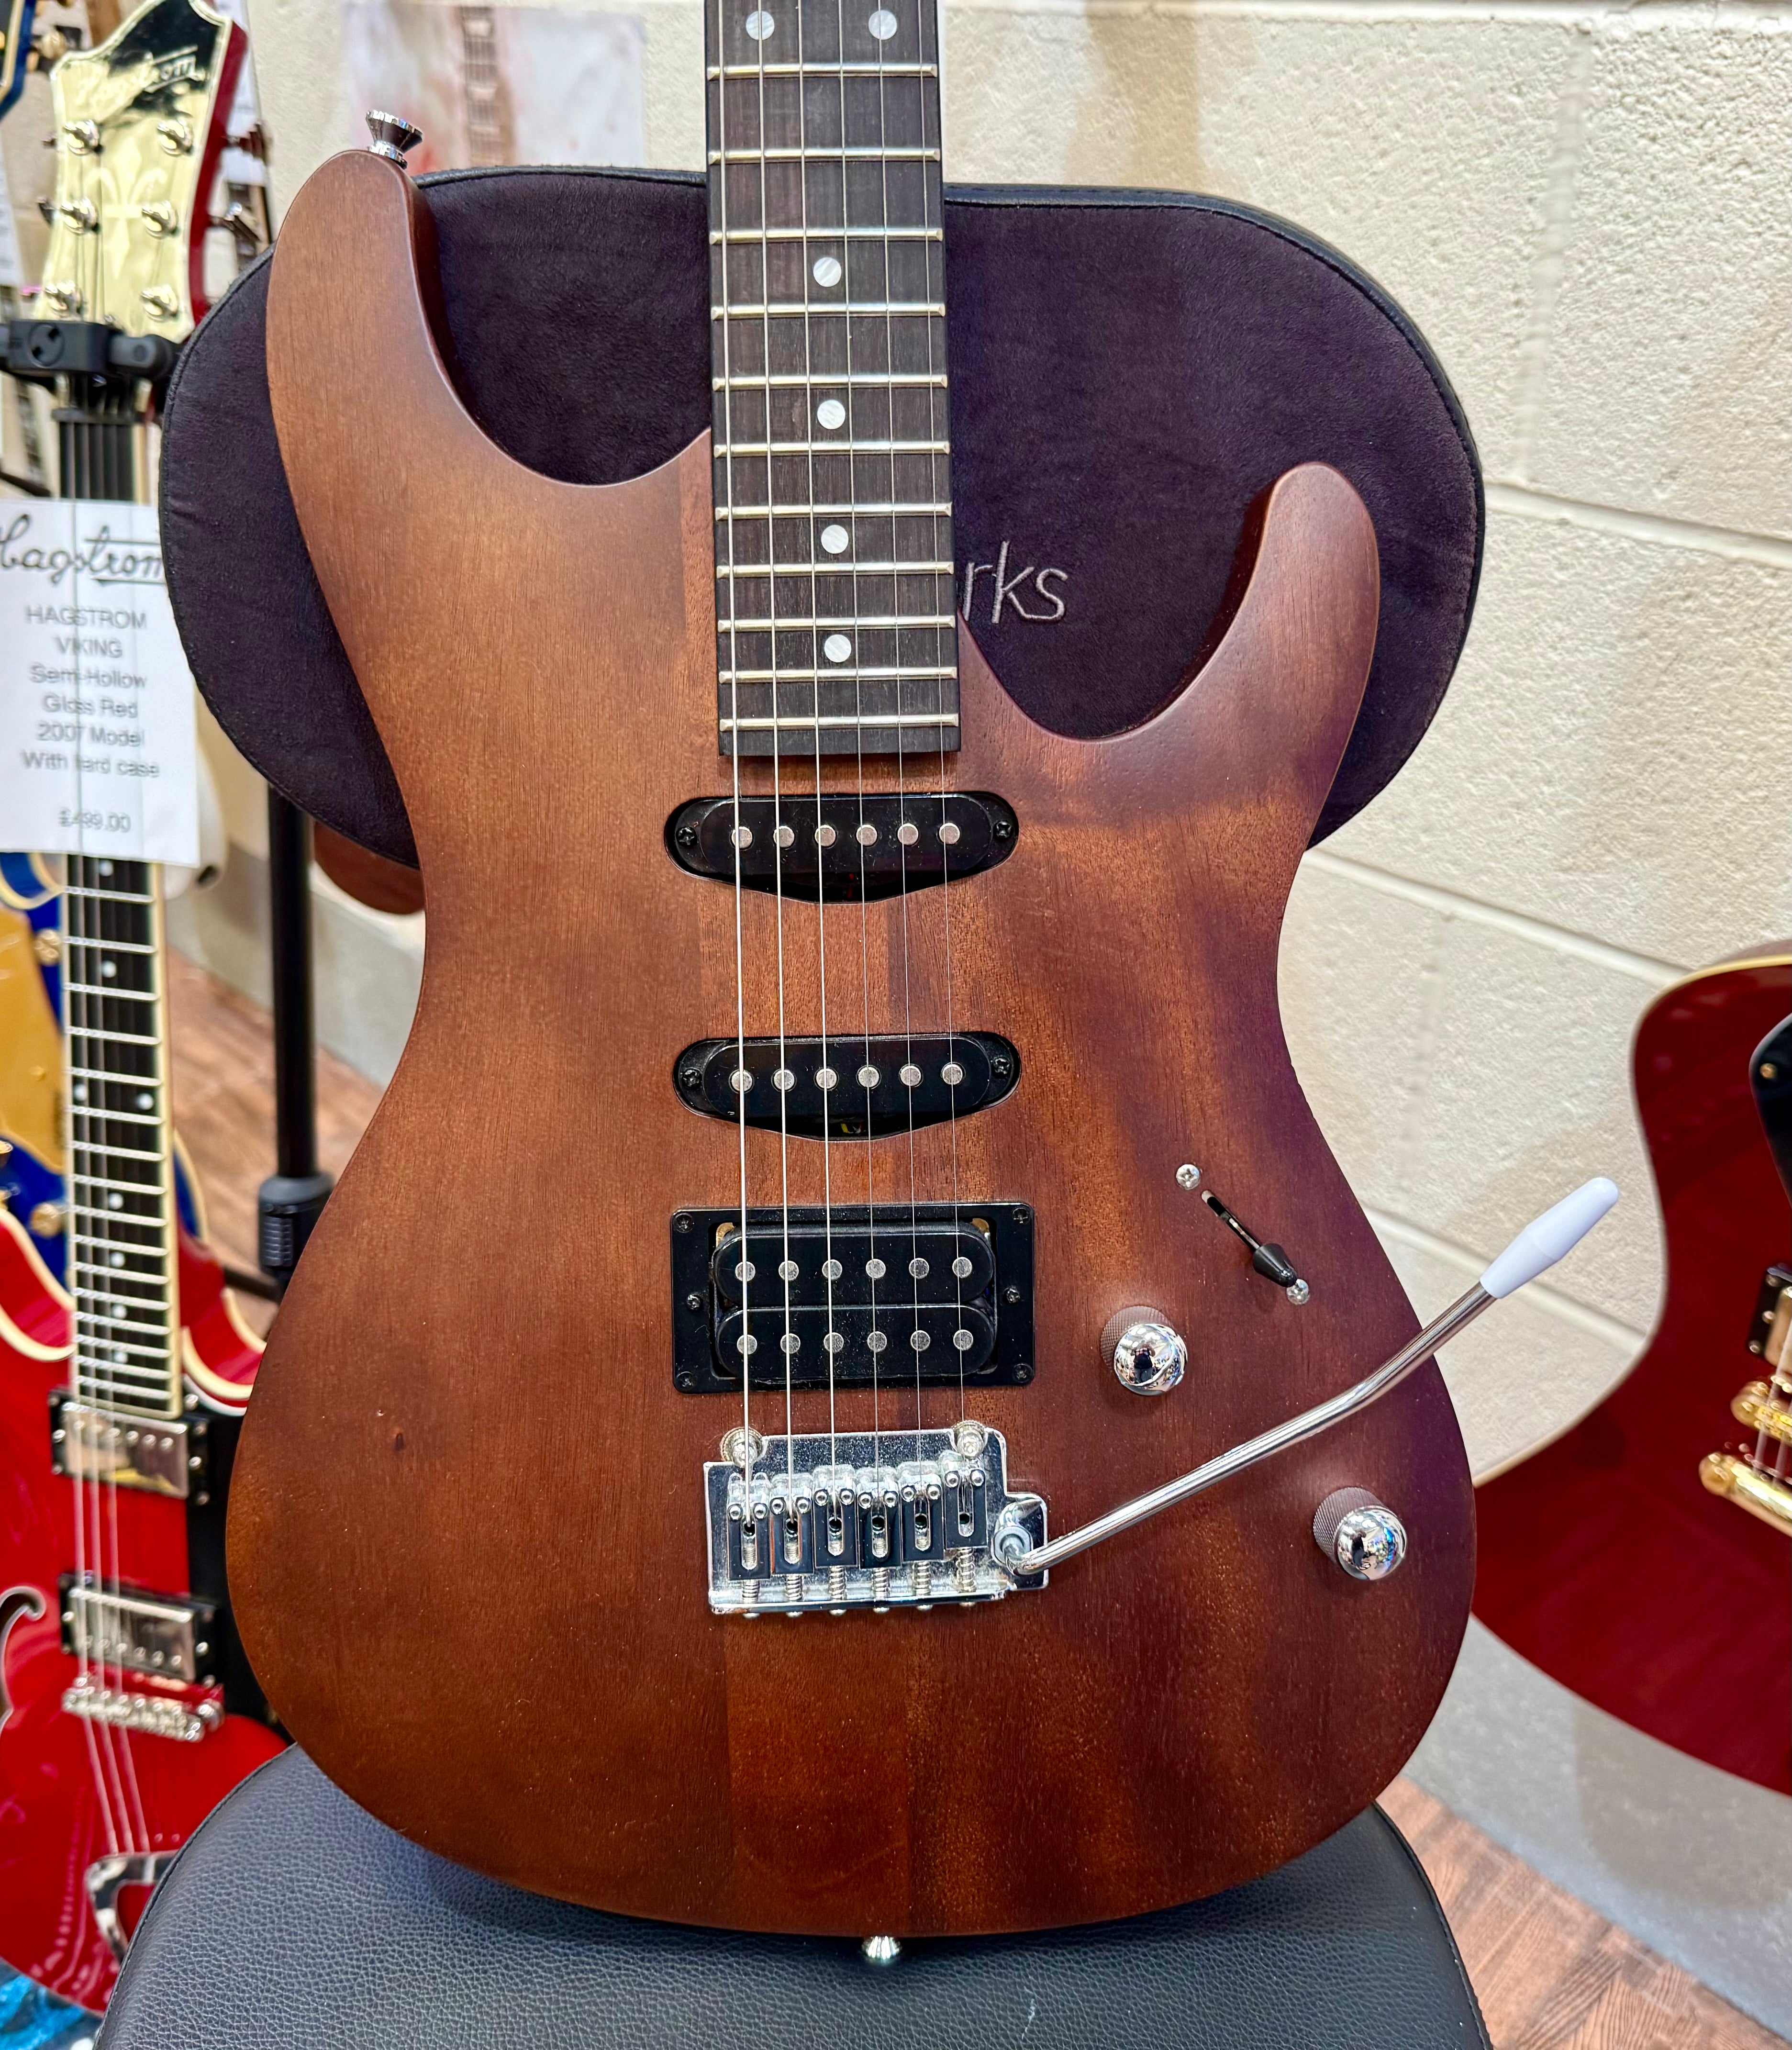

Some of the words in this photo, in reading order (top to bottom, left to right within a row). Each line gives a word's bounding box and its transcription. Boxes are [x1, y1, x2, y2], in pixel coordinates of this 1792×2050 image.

[26, 605, 146, 628] HAGSTROM
[55, 636, 122, 658] VIKING
[43, 693, 94, 714] Gloss
[100, 697, 138, 718] Red
[90, 726, 145, 747] Model
[23, 752, 67, 769] With
[74, 754, 111, 774] hard
[117, 760, 160, 778] case
[59, 808, 131, 833] £499.00
